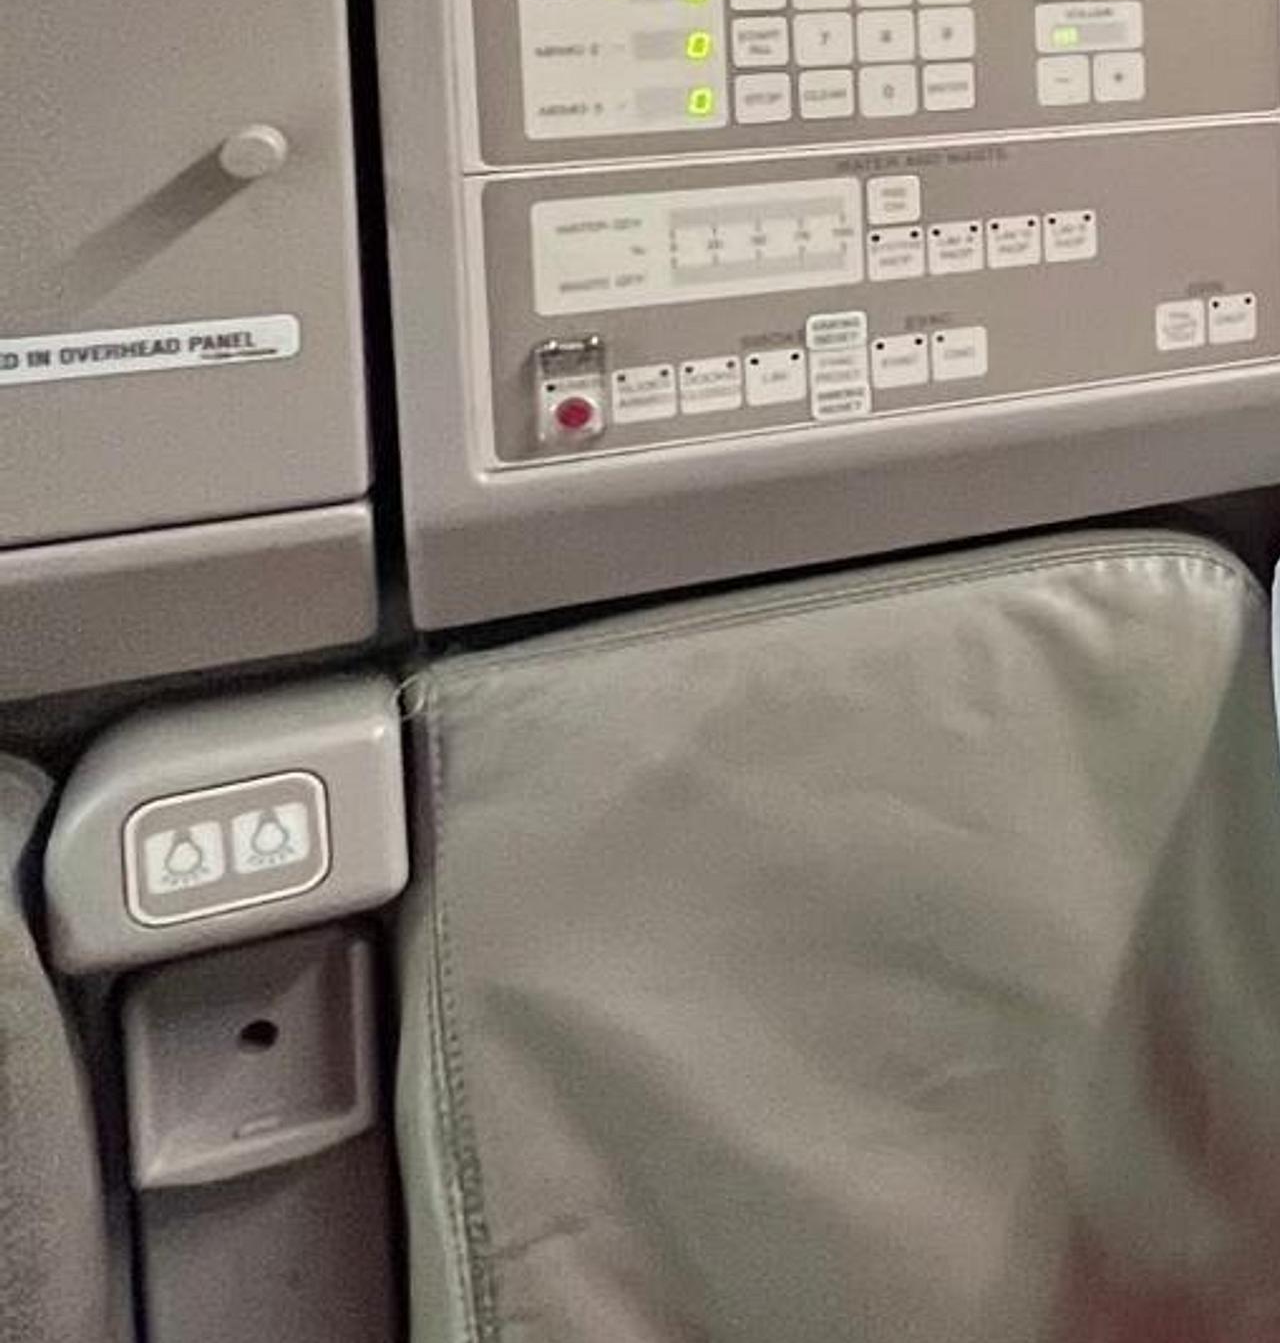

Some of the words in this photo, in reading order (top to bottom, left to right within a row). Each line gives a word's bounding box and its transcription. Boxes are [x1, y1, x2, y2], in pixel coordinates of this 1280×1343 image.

[0, 352, 19, 370] D
[27, 350, 51, 368] IN
[60, 336, 182, 366] OVERHEAD
[189, 331, 256, 352] PANEL
